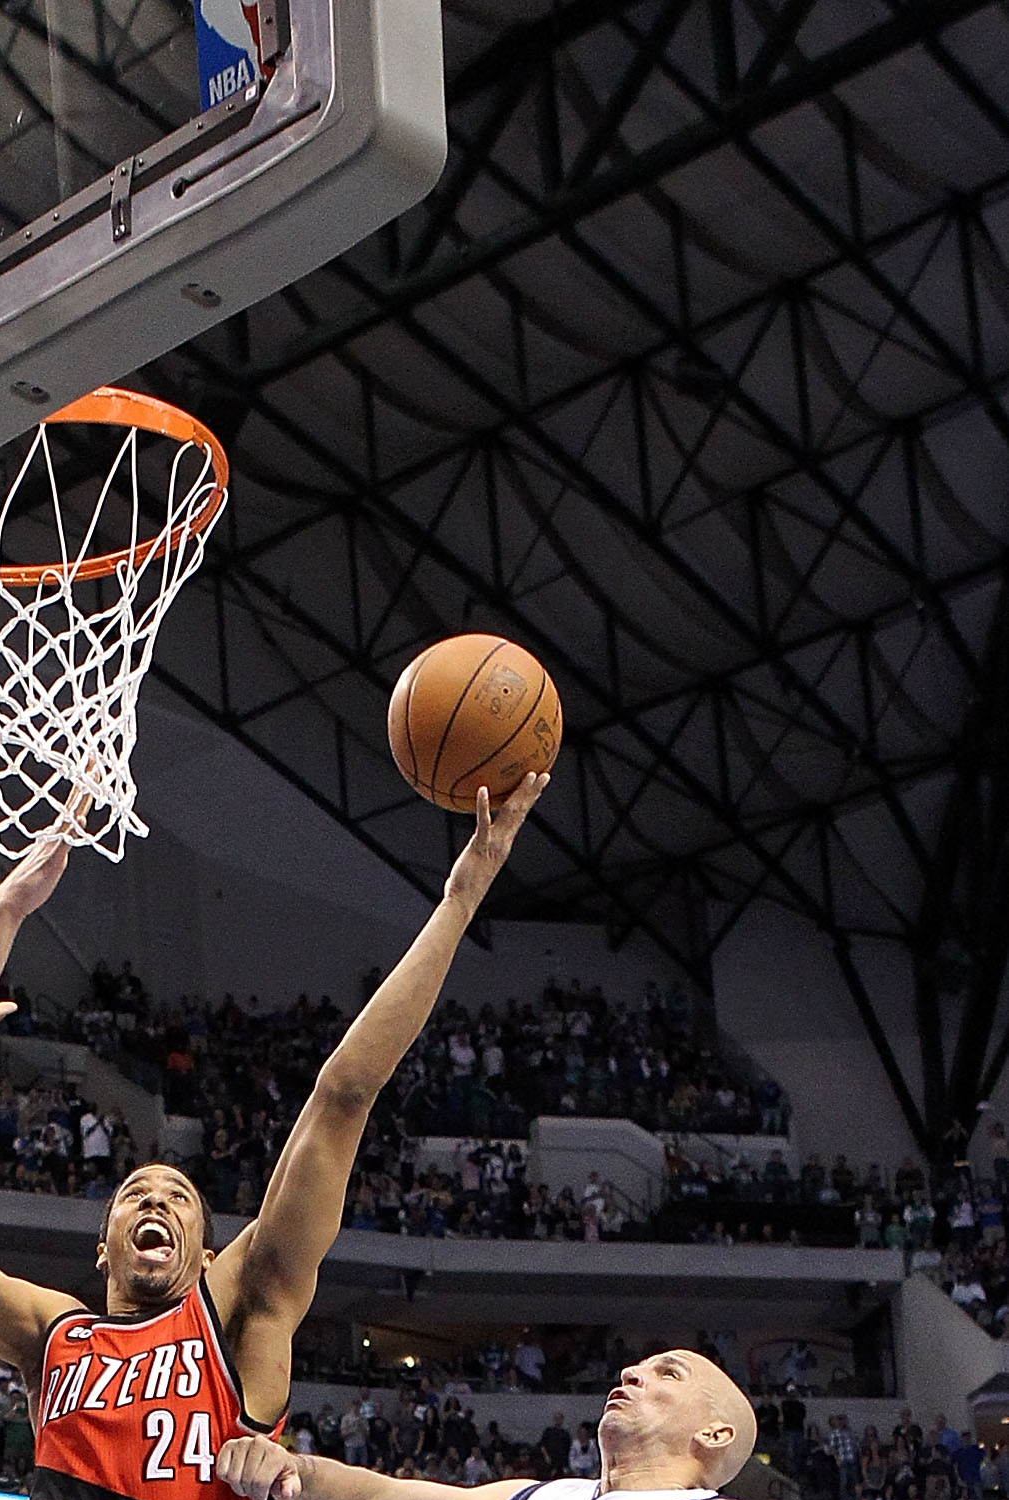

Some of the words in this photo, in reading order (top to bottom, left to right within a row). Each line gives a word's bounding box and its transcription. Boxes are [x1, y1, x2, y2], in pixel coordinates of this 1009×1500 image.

[209, 58, 250, 106] NBA
[41, 1340, 204, 1427] BLAZERS
[146, 1411, 214, 1482] 24
